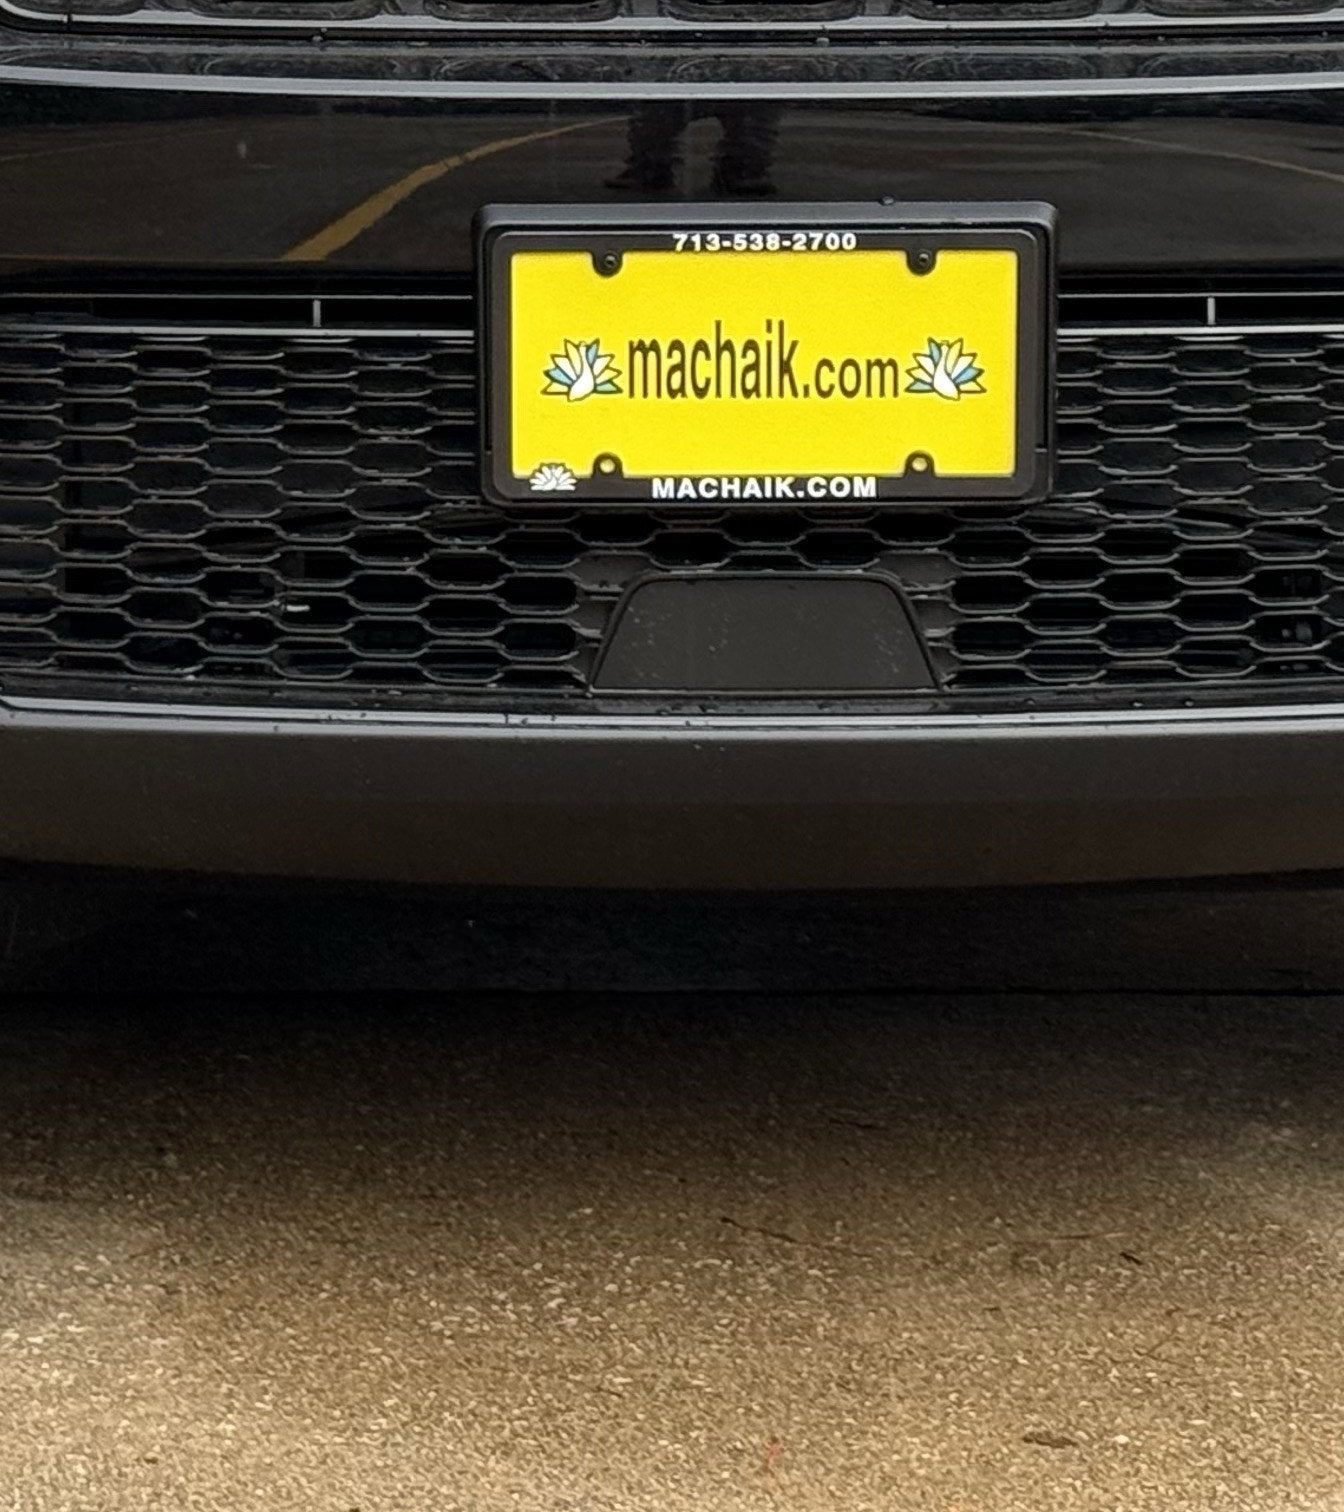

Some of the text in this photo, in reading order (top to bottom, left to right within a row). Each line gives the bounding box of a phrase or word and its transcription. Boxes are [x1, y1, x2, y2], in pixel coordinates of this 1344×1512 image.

[672, 233, 857, 251] 713-538-2700
[627, 319, 900, 400] machaik.com
[651, 476, 877, 499] MACHAIK.COM
